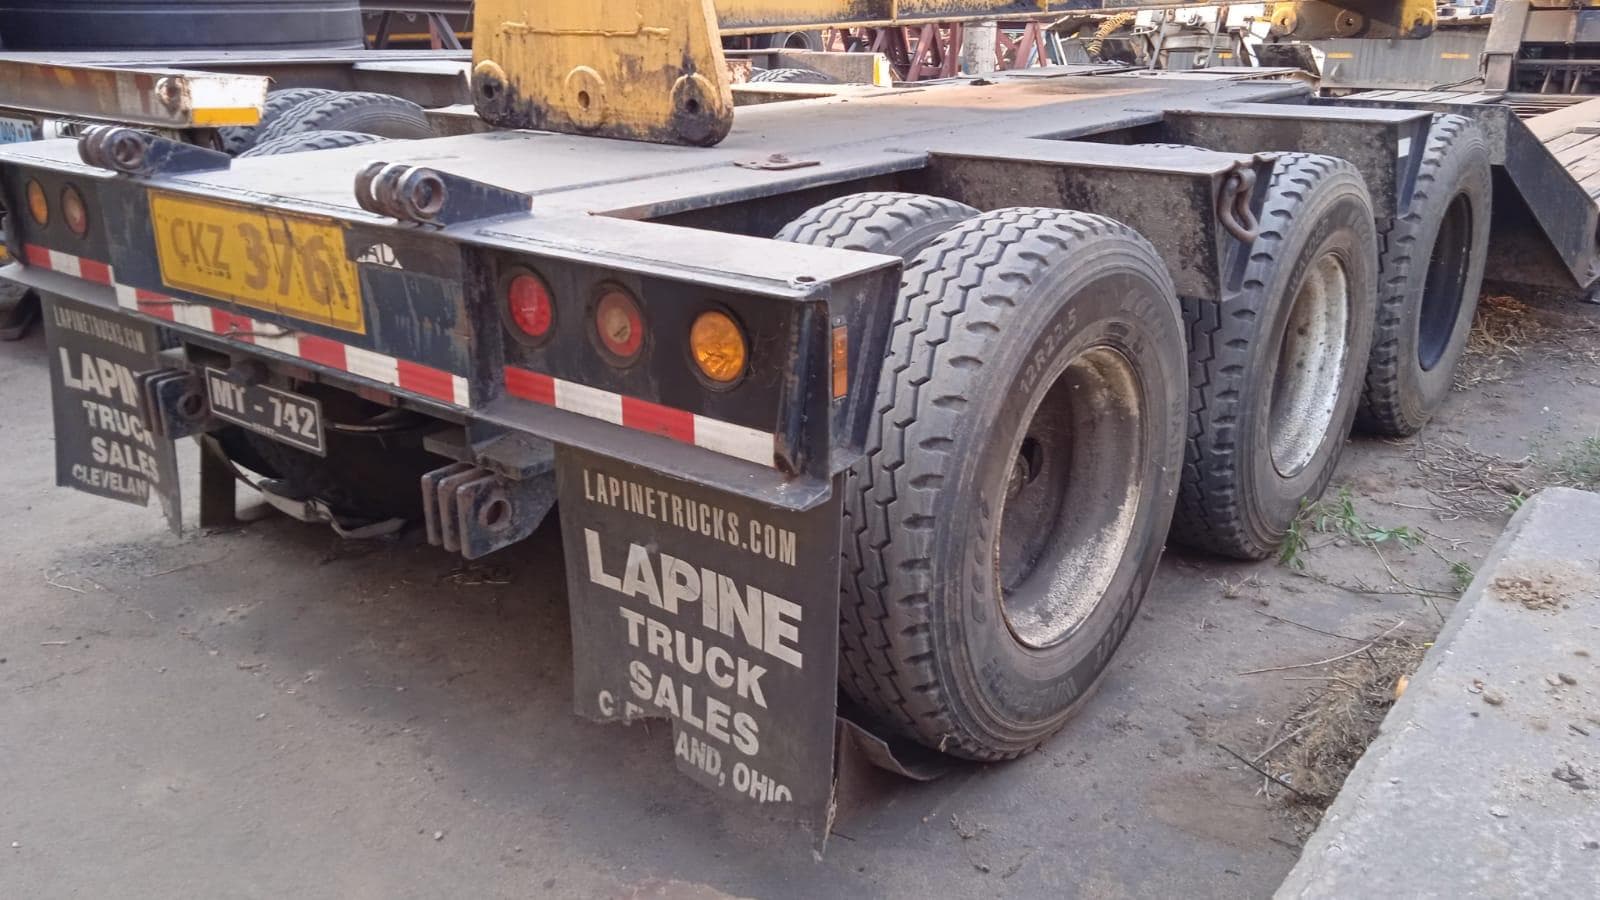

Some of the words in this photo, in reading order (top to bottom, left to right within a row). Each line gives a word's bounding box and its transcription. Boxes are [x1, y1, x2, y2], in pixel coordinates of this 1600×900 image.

[53, 304, 146, 354] LAPINETRUCKS.COM
[1020, 308, 1078, 394] 12R22.5
[59, 346, 140, 408] LAPIN
[268, 396, 317, 440] 742
[72, 463, 148, 499] CLEVELAN
[91, 436, 160, 483] SALES
[584, 469, 797, 567] LAPINETRUCKS.COM
[584, 528, 802, 669] LAPINE
[619, 607, 768, 709] TRUCK
[629, 660, 760, 756] SALES
